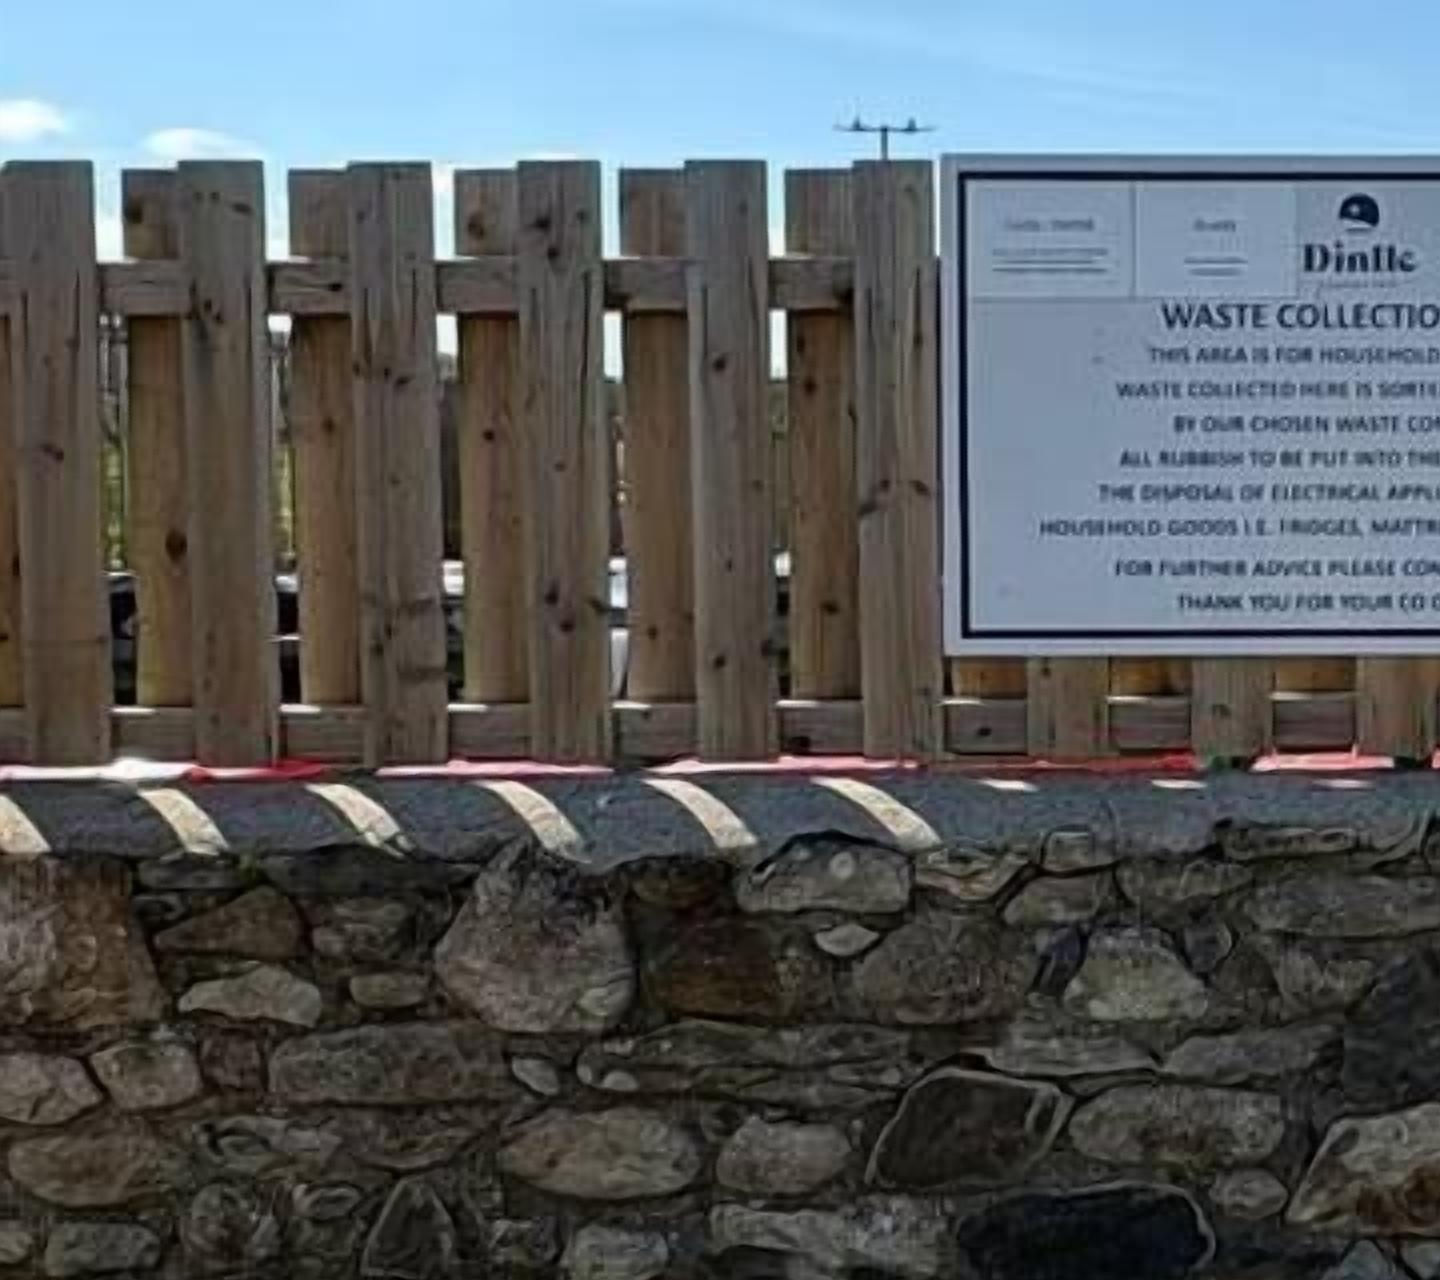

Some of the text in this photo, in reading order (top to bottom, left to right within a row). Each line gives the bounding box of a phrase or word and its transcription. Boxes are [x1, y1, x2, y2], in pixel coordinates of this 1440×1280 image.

[1161, 303, 1269, 329] WASTE
[1151, 347, 1190, 364] THIS
[1196, 347, 1247, 364] AREA
[1252, 347, 1268, 364] IS
[1276, 347, 1313, 364] FOR
[1320, 347, 1440, 364] HOUSEHOLD
[1116, 381, 1182, 398] WASTE
[1187, 381, 1296, 398] COLLECTED
[1300, 381, 1348, 398] HERE
[1355, 381, 1372, 398] IS
[1173, 415, 1196, 432] BY
[1201, 415, 1244, 432] OUR
[1250, 415, 1329, 432] CHOSEN
[1336, 415, 1399, 432] WASTE
[1119, 450, 1152, 467] ALL
[1159, 450, 1244, 467] RUBBISH
[1251, 450, 1276, 467] TO
[1281, 450, 1301, 467] BE
[1310, 450, 1348, 467] PUT
[1354, 450, 1401, 467] INTO
[1408, 450, 1440, 467] THE
[1100, 484, 1134, 501] THE
[1140, 484, 1233, 501] DISPOSAL
[1240, 484, 1264, 501] OF
[1271, 484, 1379, 501] ELECTRICAL
[1040, 518, 1160, 536] HOUSEHOLD
[1167, 518, 1237, 536] GOODS
[1115, 559, 1152, 577] FOR
[1159, 559, 1247, 577] FURTHER
[1251, 559, 1322, 577] ADVICE
[1327, 559, 1395, 577] PLEASE
[1178, 594, 1243, 611] THANK
[1249, 594, 1288, 611] YOU
[1295, 594, 1333, 611] FOR
[1339, 594, 1393, 611] YOUR
